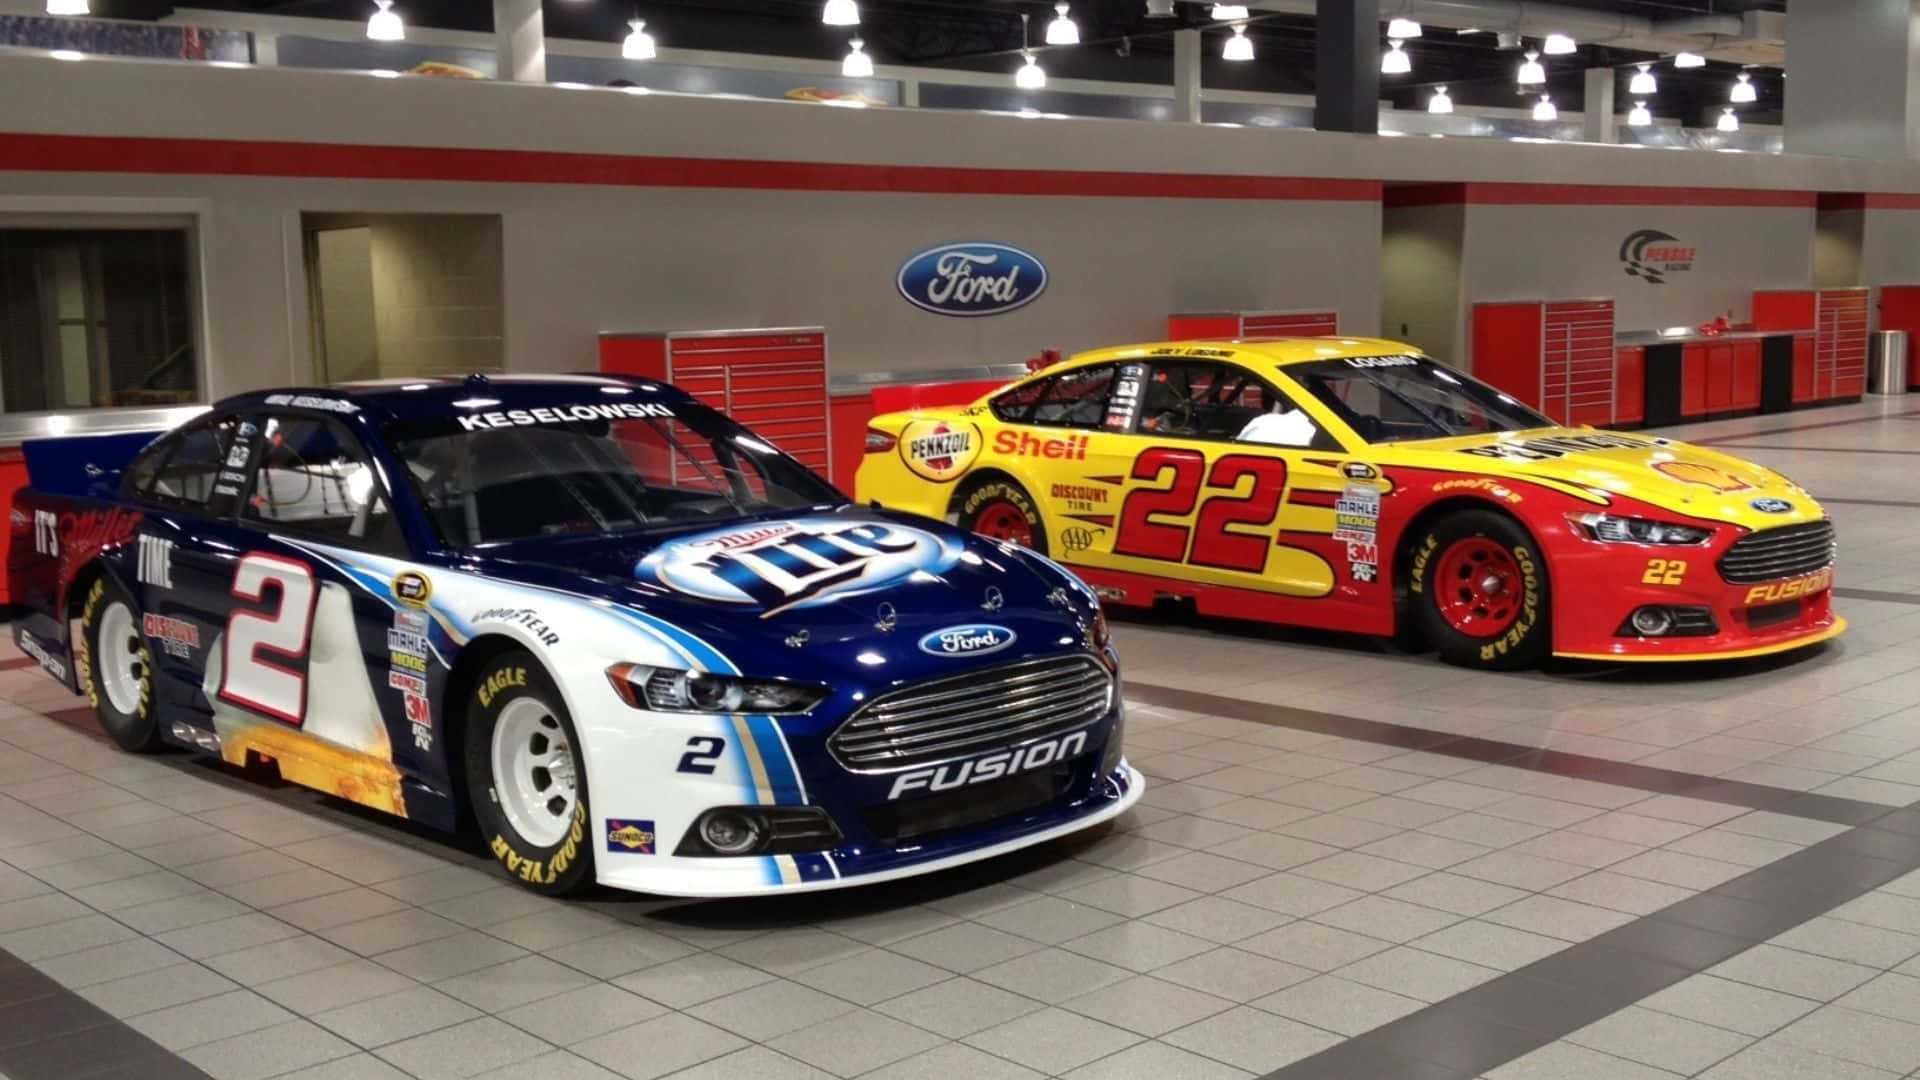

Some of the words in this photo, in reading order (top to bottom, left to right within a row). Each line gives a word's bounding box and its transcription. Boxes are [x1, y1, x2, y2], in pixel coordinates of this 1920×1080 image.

[928, 251, 1020, 304] Ford
[457, 404, 676, 430] KESELOWSKI
[911, 432, 971, 460] PENNZOIL
[992, 430, 1089, 461] Shell
[1051, 484, 1108, 504] DISCOUNT
[1067, 500, 1093, 512] TIRE
[1112, 446, 1287, 574] 22
[1336, 501, 1378, 516] MAHLE
[137, 533, 174, 589] TIME
[1349, 543, 1377, 563] 3M
[1411, 534, 1438, 593] EAGLE
[1641, 559, 1687, 585] 22
[1745, 571, 1831, 604] FUSION
[1480, 546, 1538, 660] GOODYEAR
[217, 551, 315, 727] 2
[388, 630, 428, 651] MAHLE
[472, 608, 560, 648] GOODYEAR
[940, 631, 1001, 652] Ford
[391, 652, 427, 672] MOOG
[477, 667, 527, 707] EAGLE
[406, 694, 431, 727] 3M
[676, 736, 726, 776] 2
[887, 730, 1088, 800] FUSION
[491, 799, 586, 885] GOODYEAR
[608, 831, 654, 843] SUNOCO
